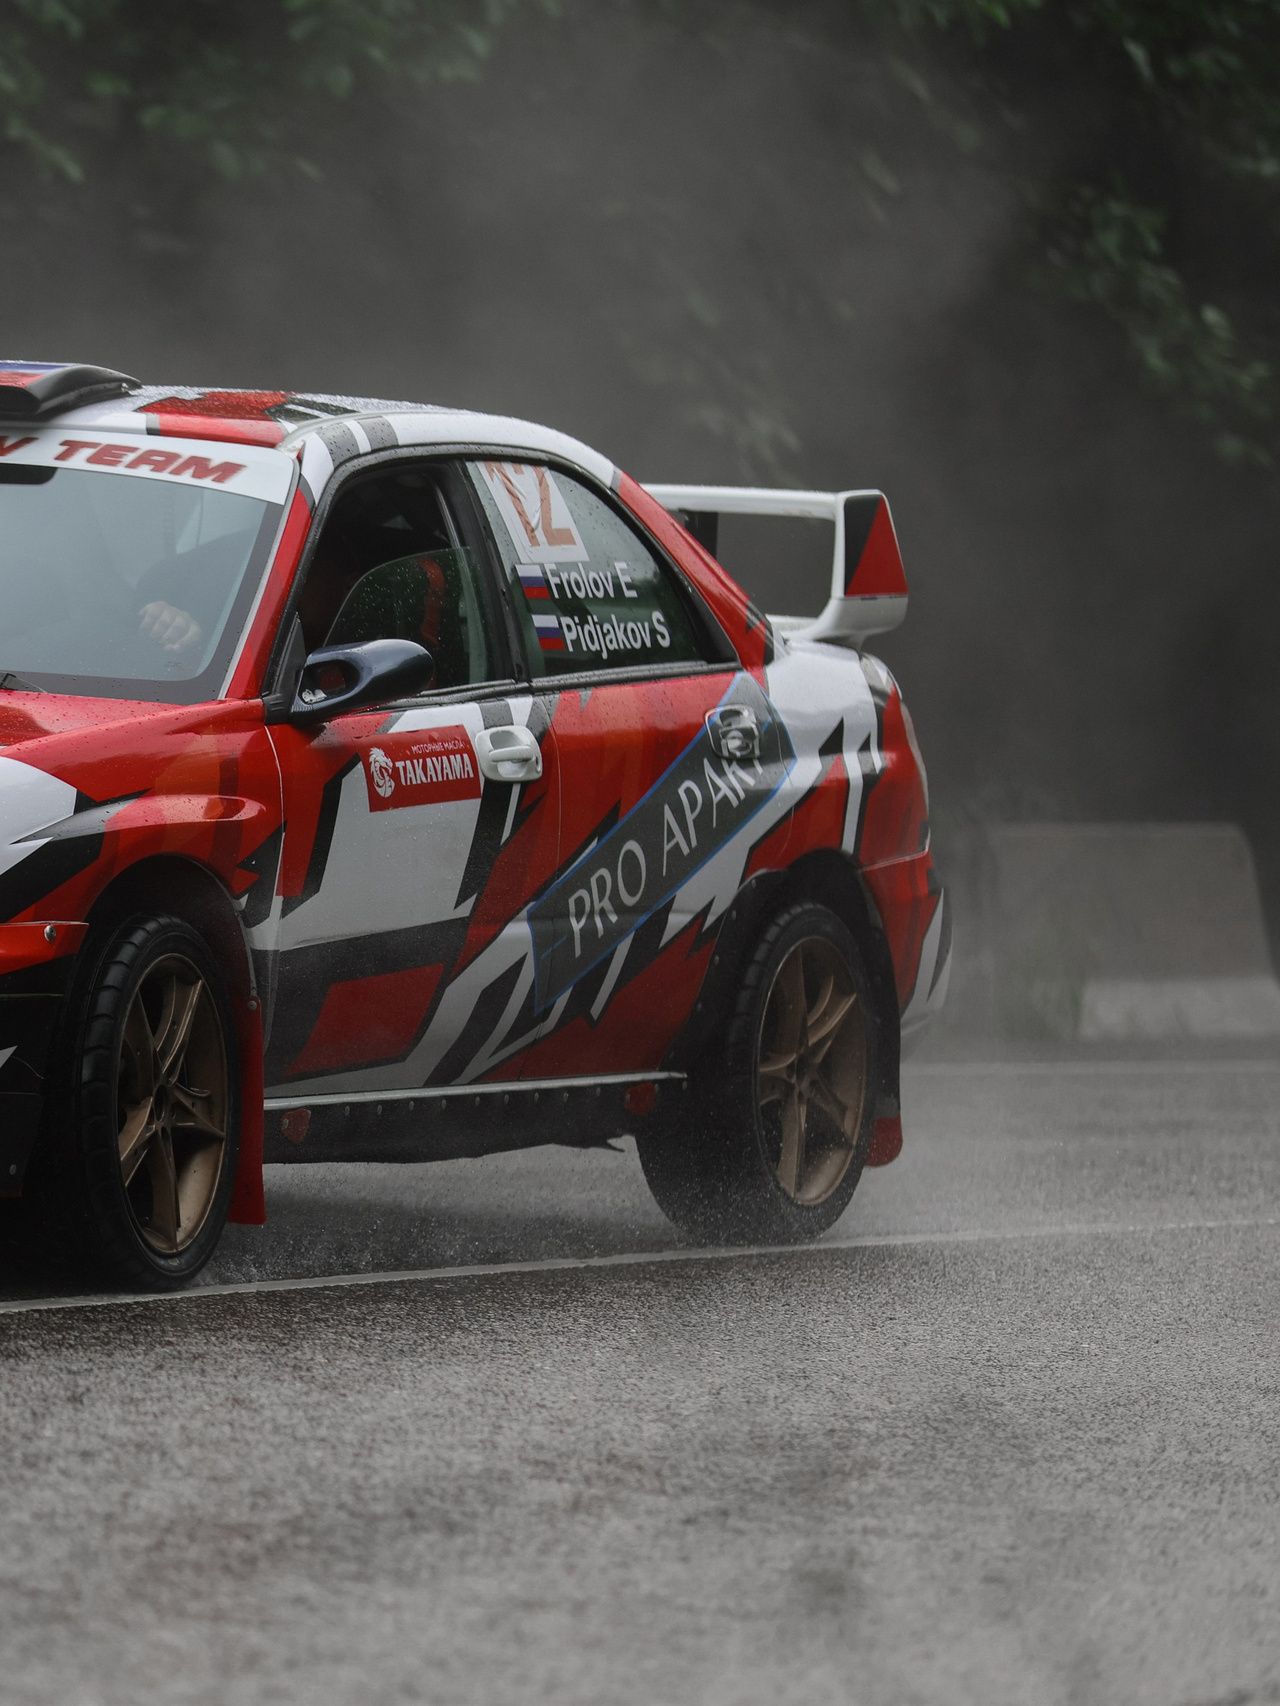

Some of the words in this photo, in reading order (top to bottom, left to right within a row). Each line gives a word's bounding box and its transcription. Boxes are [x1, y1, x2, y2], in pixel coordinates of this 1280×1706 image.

[56, 439, 247, 484] TEAM
[543, 562, 615, 599] Frolov
[613, 562, 638, 598] E
[560, 613, 652, 660] Pidjakov
[651, 610, 671, 648] S
[411, 742, 443, 754] МОТОРНЫЕ
[444, 740, 465, 751] МАСЛА
[395, 753, 475, 786] TAKAYAMA
[567, 838, 647, 958] PRO
